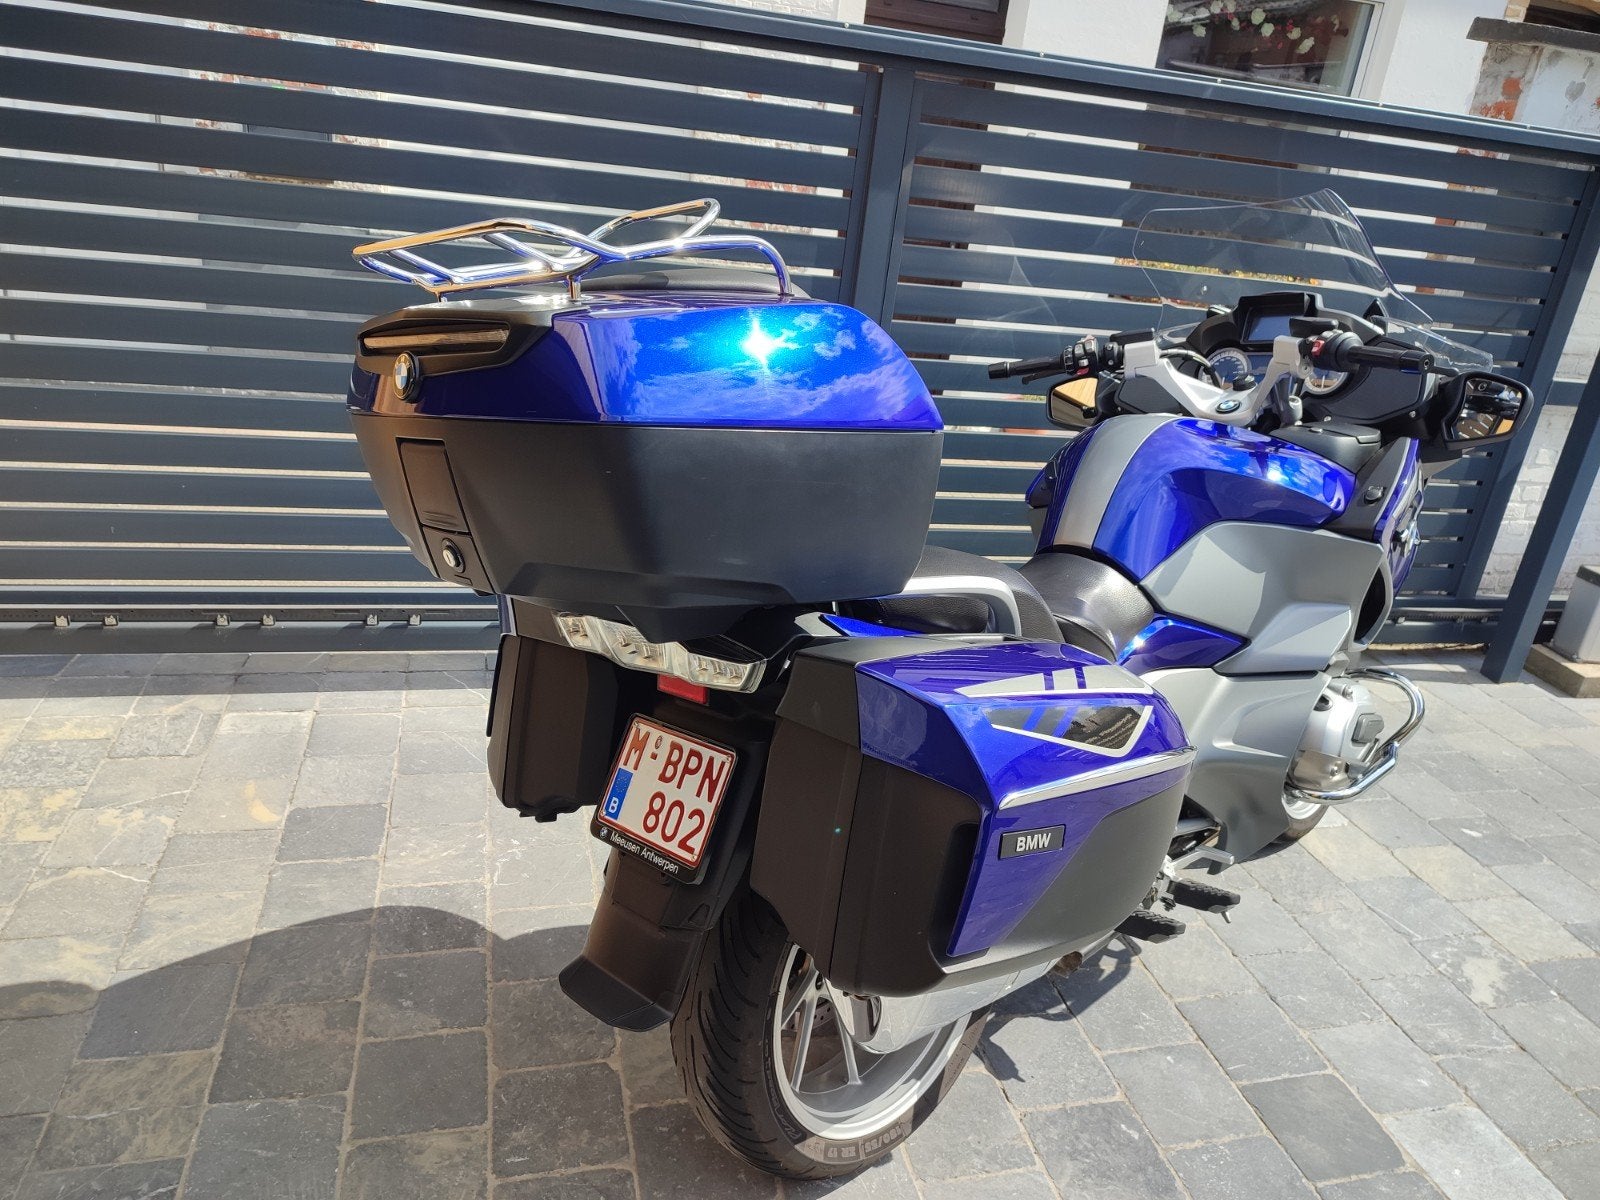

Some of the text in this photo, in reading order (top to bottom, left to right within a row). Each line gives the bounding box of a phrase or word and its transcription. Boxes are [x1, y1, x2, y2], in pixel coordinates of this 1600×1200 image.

[608, 796, 620, 814] B
[642, 791, 705, 854] 802
[609, 831, 679, 874] Meeusen Antwerpen
[1015, 832, 1051, 852] BMW
